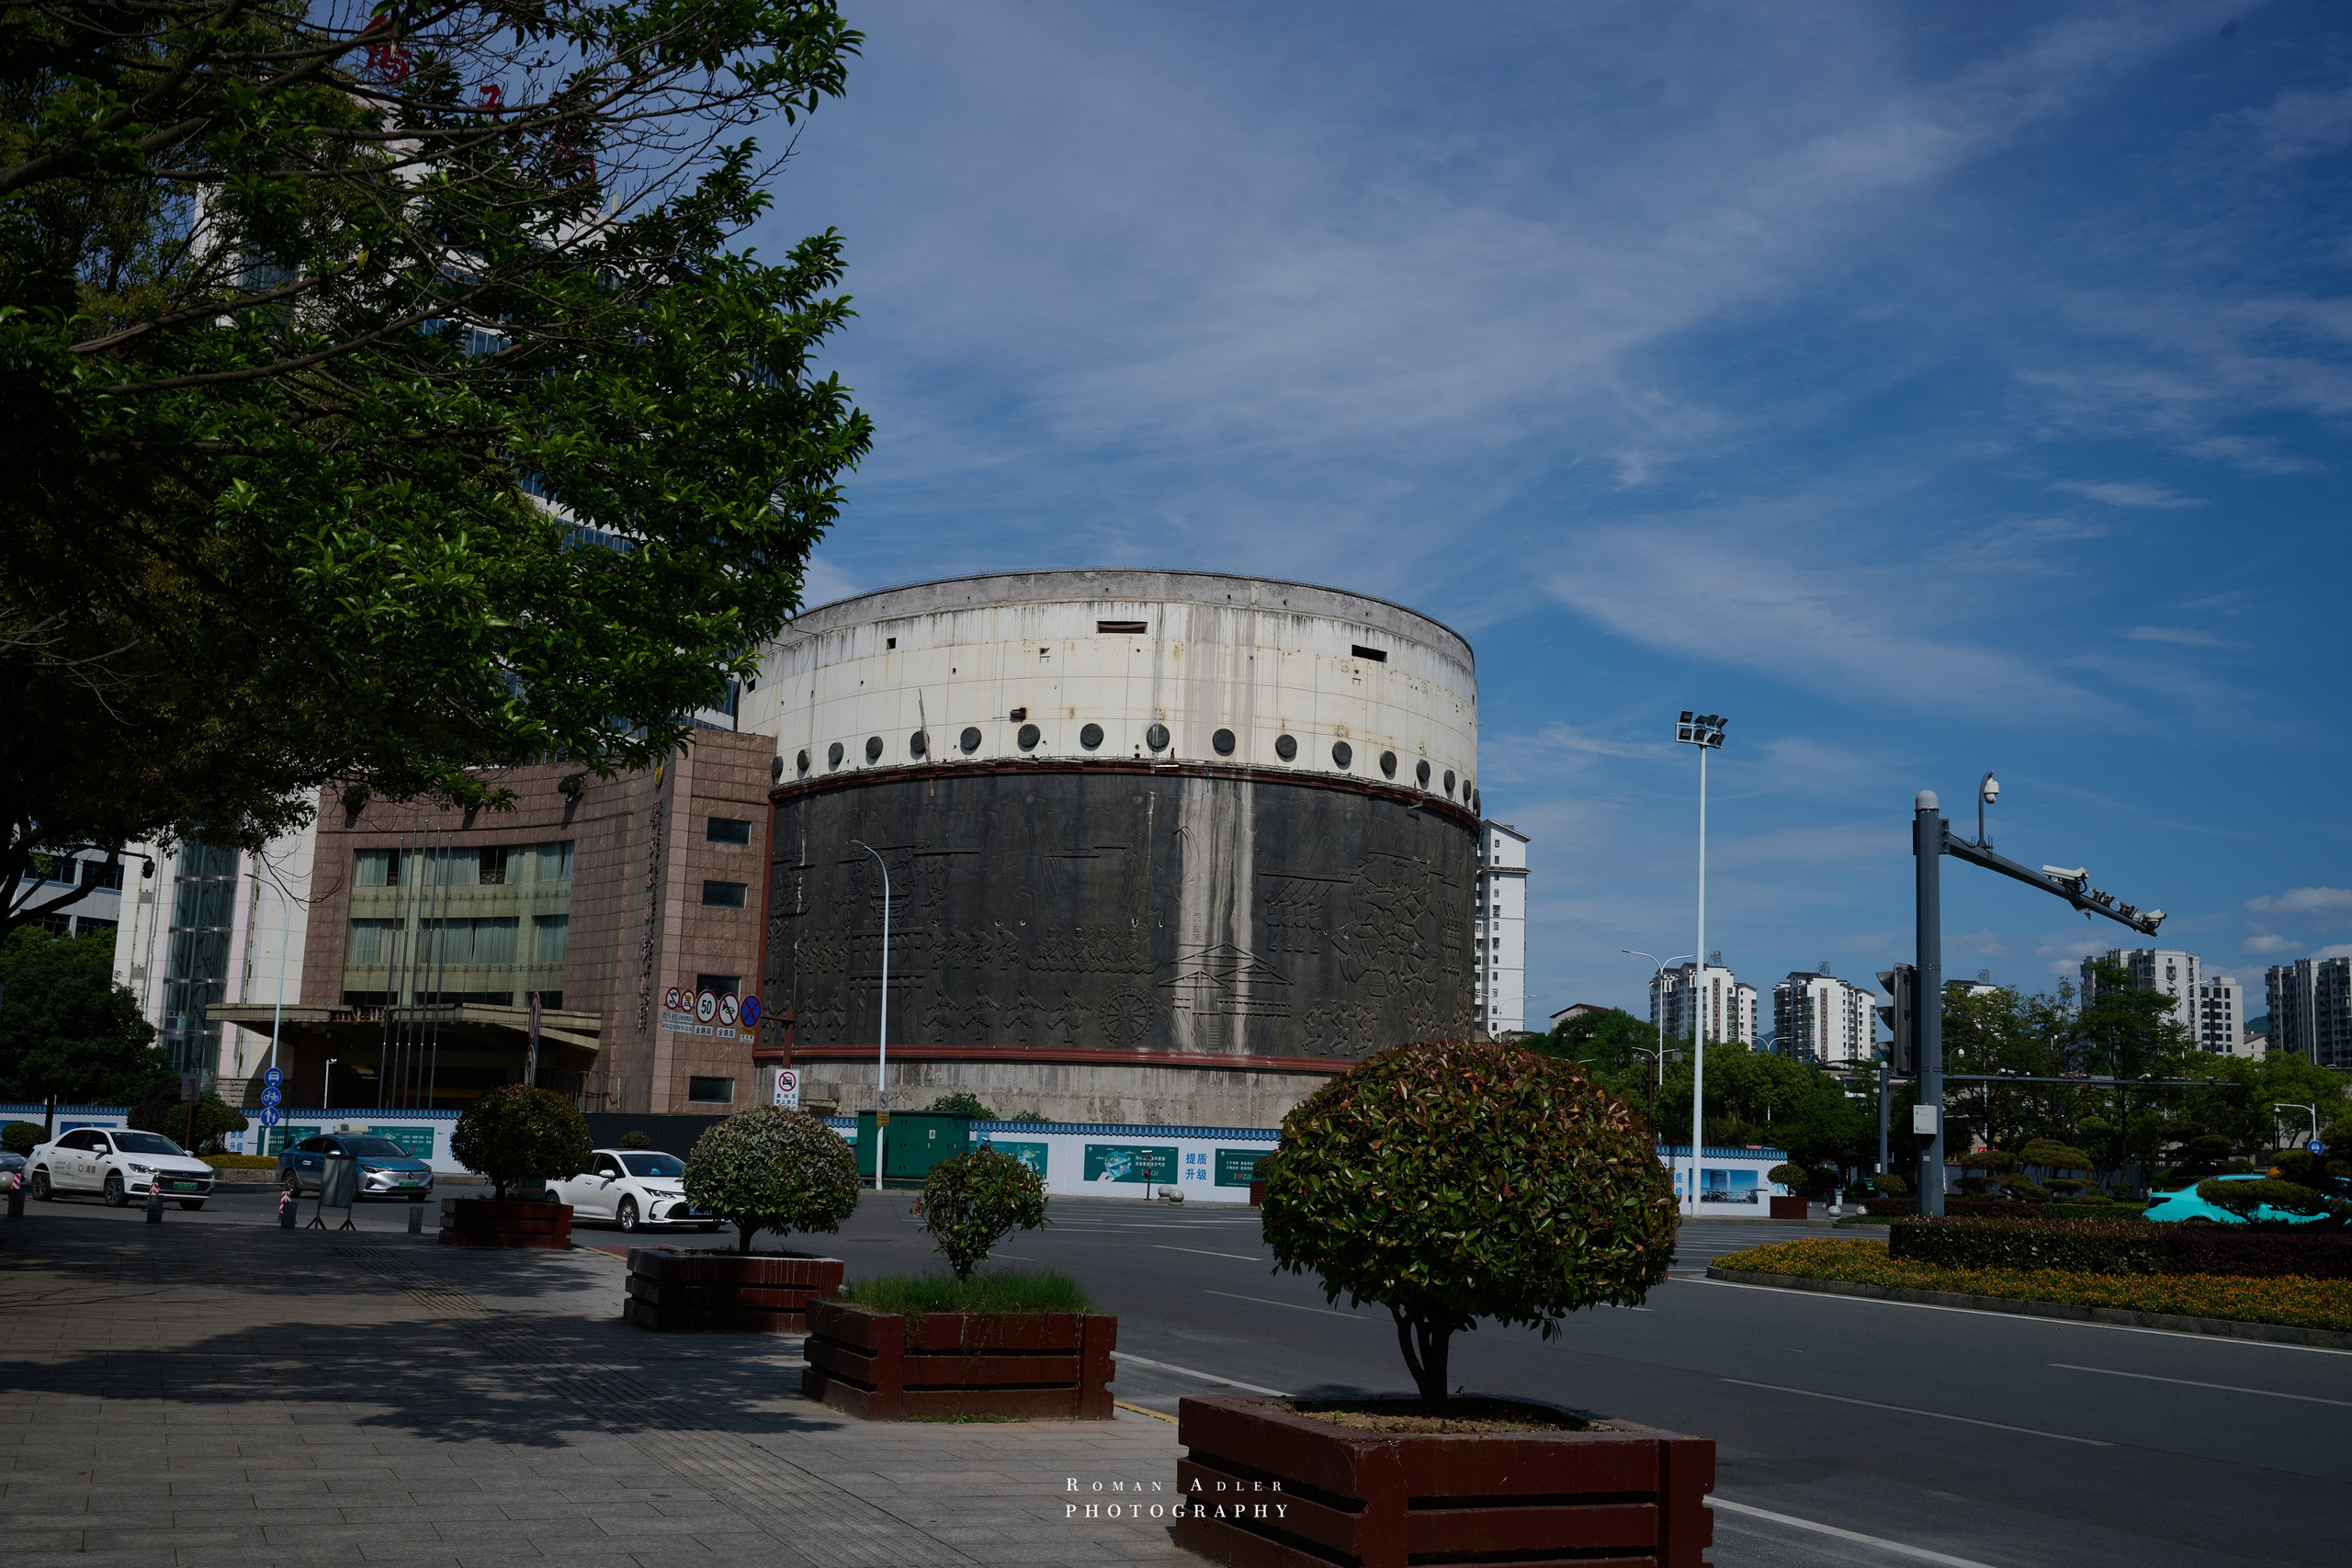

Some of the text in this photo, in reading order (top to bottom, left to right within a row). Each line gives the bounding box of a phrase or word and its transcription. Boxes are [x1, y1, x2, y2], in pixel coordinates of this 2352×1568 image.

[701, 999, 712, 1015] 50
[695, 1026, 711, 1035] 全路段
[718, 1029, 734, 1037] 全路段
[230, 1142, 243, 1152] 升级
[1185, 1153, 1207, 1165] 提质
[85, 1165, 96, 1175] 滴滴
[1185, 1168, 1207, 1180] 升级
